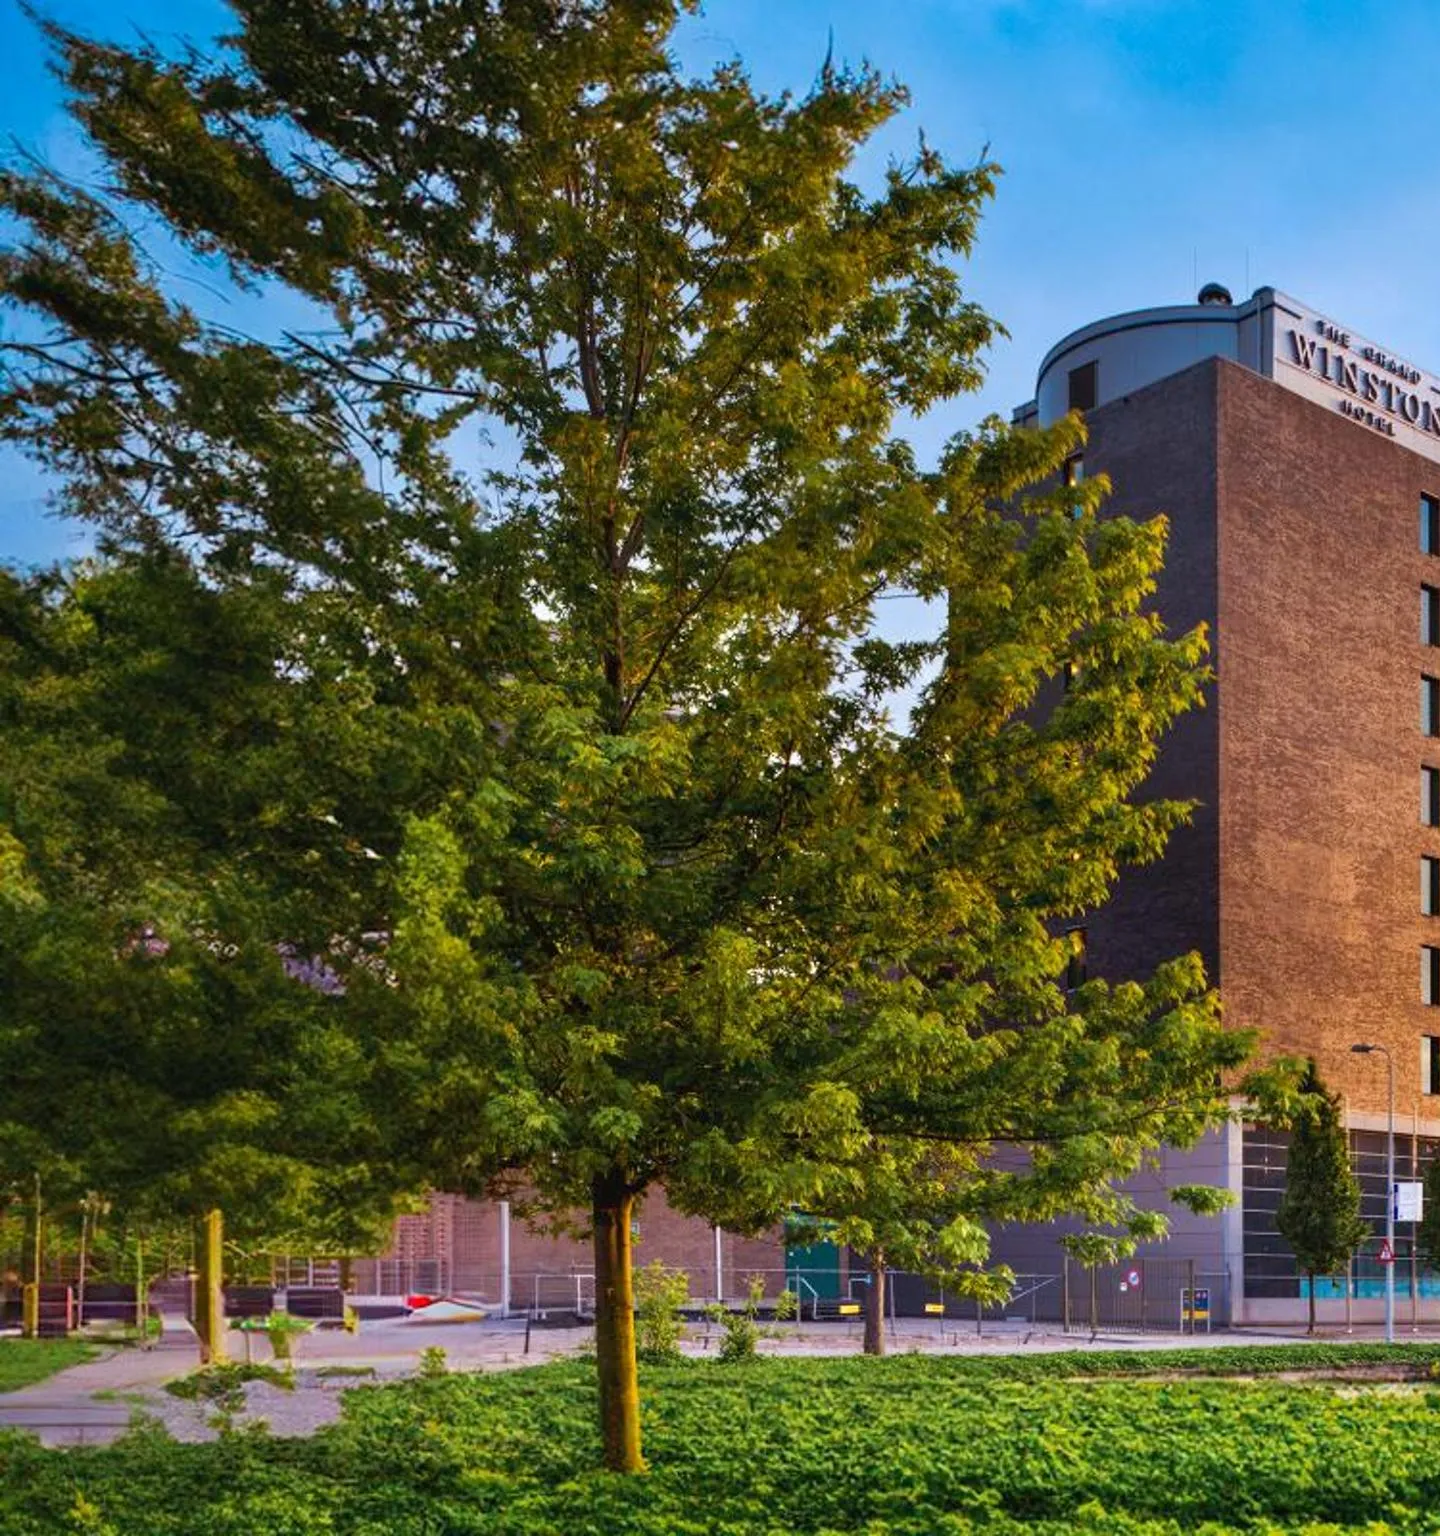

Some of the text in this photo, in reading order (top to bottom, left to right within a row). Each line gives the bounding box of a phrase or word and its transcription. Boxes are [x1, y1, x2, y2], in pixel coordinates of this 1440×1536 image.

[1316, 320, 1421, 385] THE GRAND
[1339, 399, 1395, 436] HOTEL
